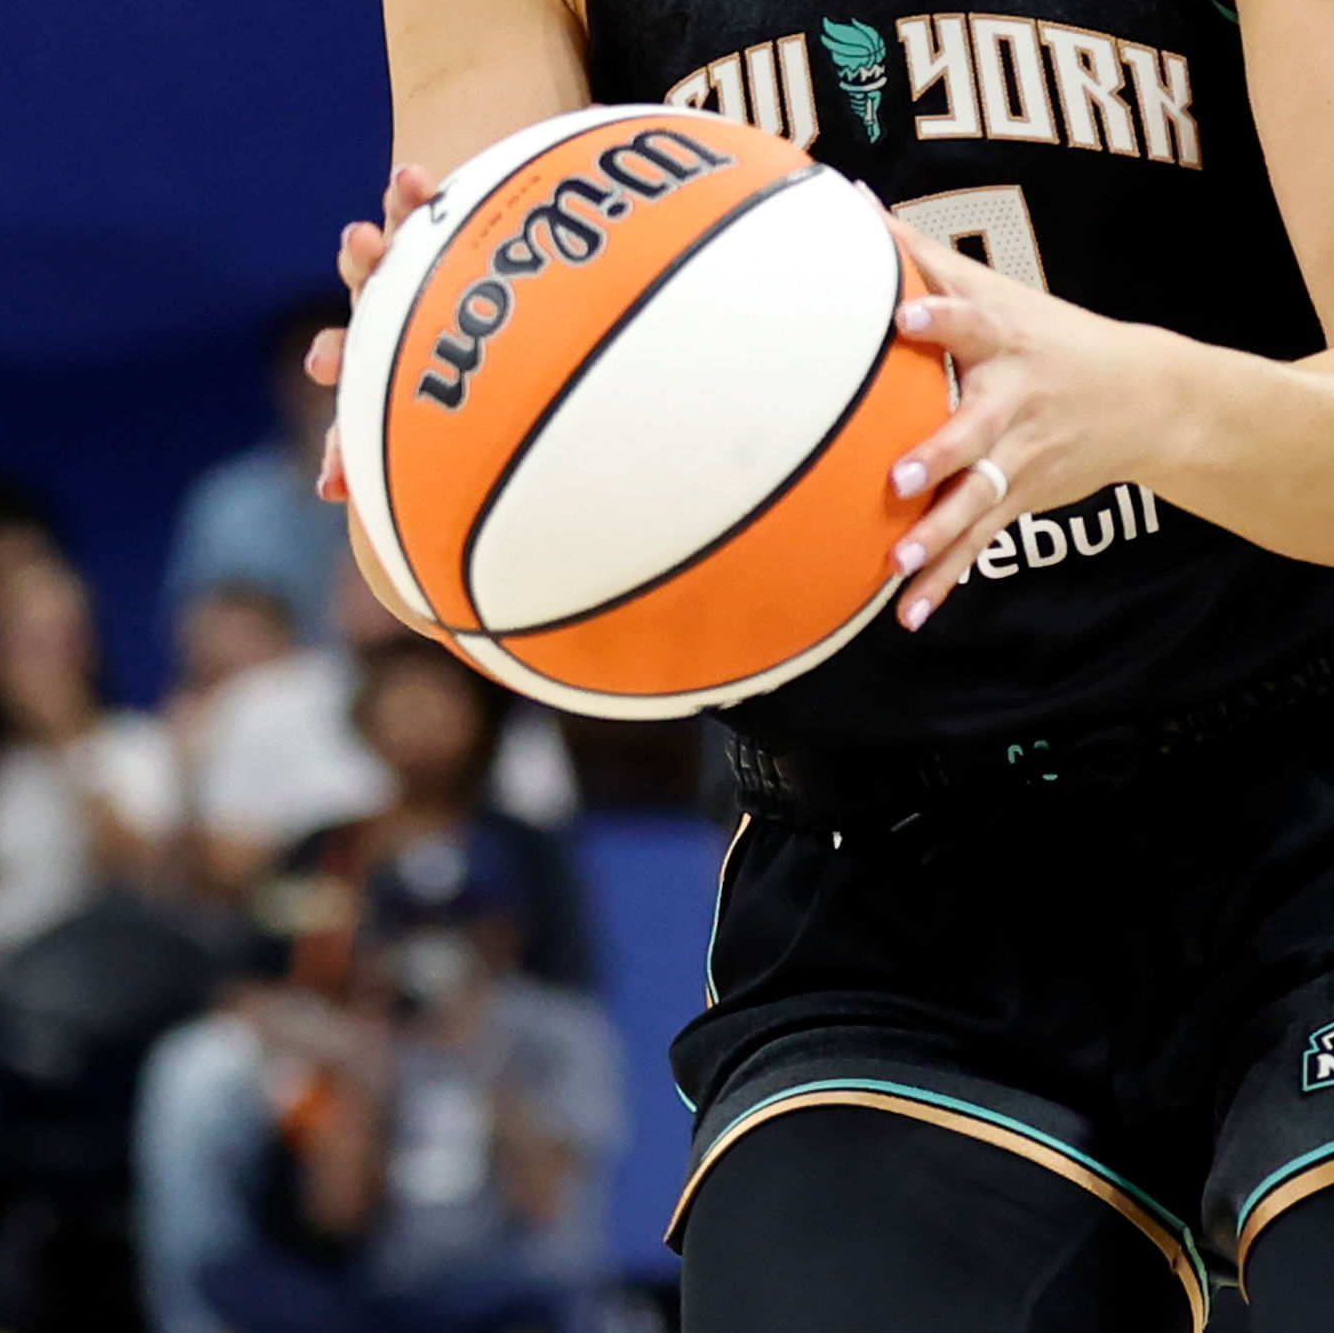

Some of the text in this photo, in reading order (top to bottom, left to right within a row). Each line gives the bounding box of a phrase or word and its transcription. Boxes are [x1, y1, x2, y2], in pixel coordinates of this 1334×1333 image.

[895, 11, 1203, 171] YORK
[414, 128, 739, 415] Wilson
[957, 483, 1160, 585] ebull
